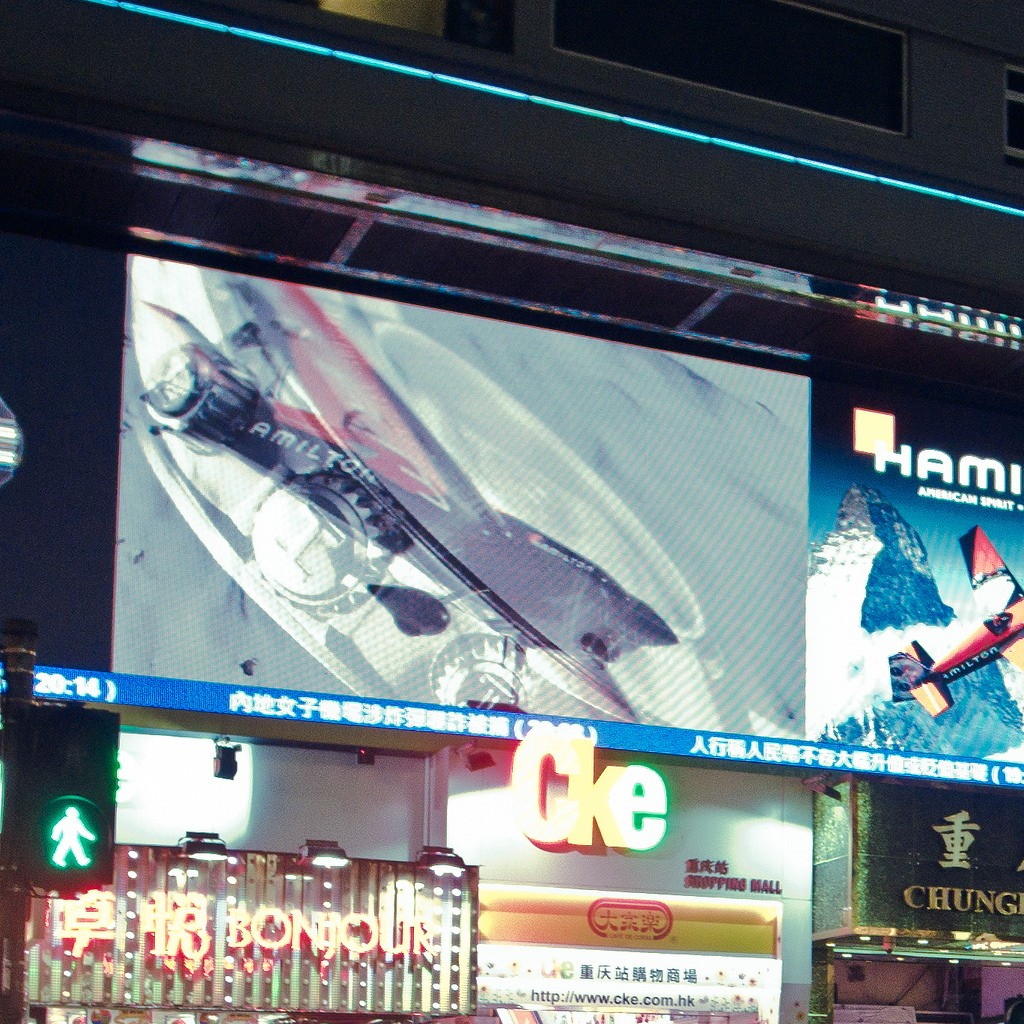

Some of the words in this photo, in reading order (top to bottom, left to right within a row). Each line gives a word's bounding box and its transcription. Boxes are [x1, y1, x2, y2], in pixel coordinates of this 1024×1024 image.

[917, 485, 979, 506] AMERICAN
[980, 496, 1016, 512] SPIRIT
[683, 875, 748, 893] SHOPPING
[750, 878, 783, 895] MALL
[227, 907, 439, 962] BONJOUR
[530, 989, 696, 1008] http://www.cke.com.hk
